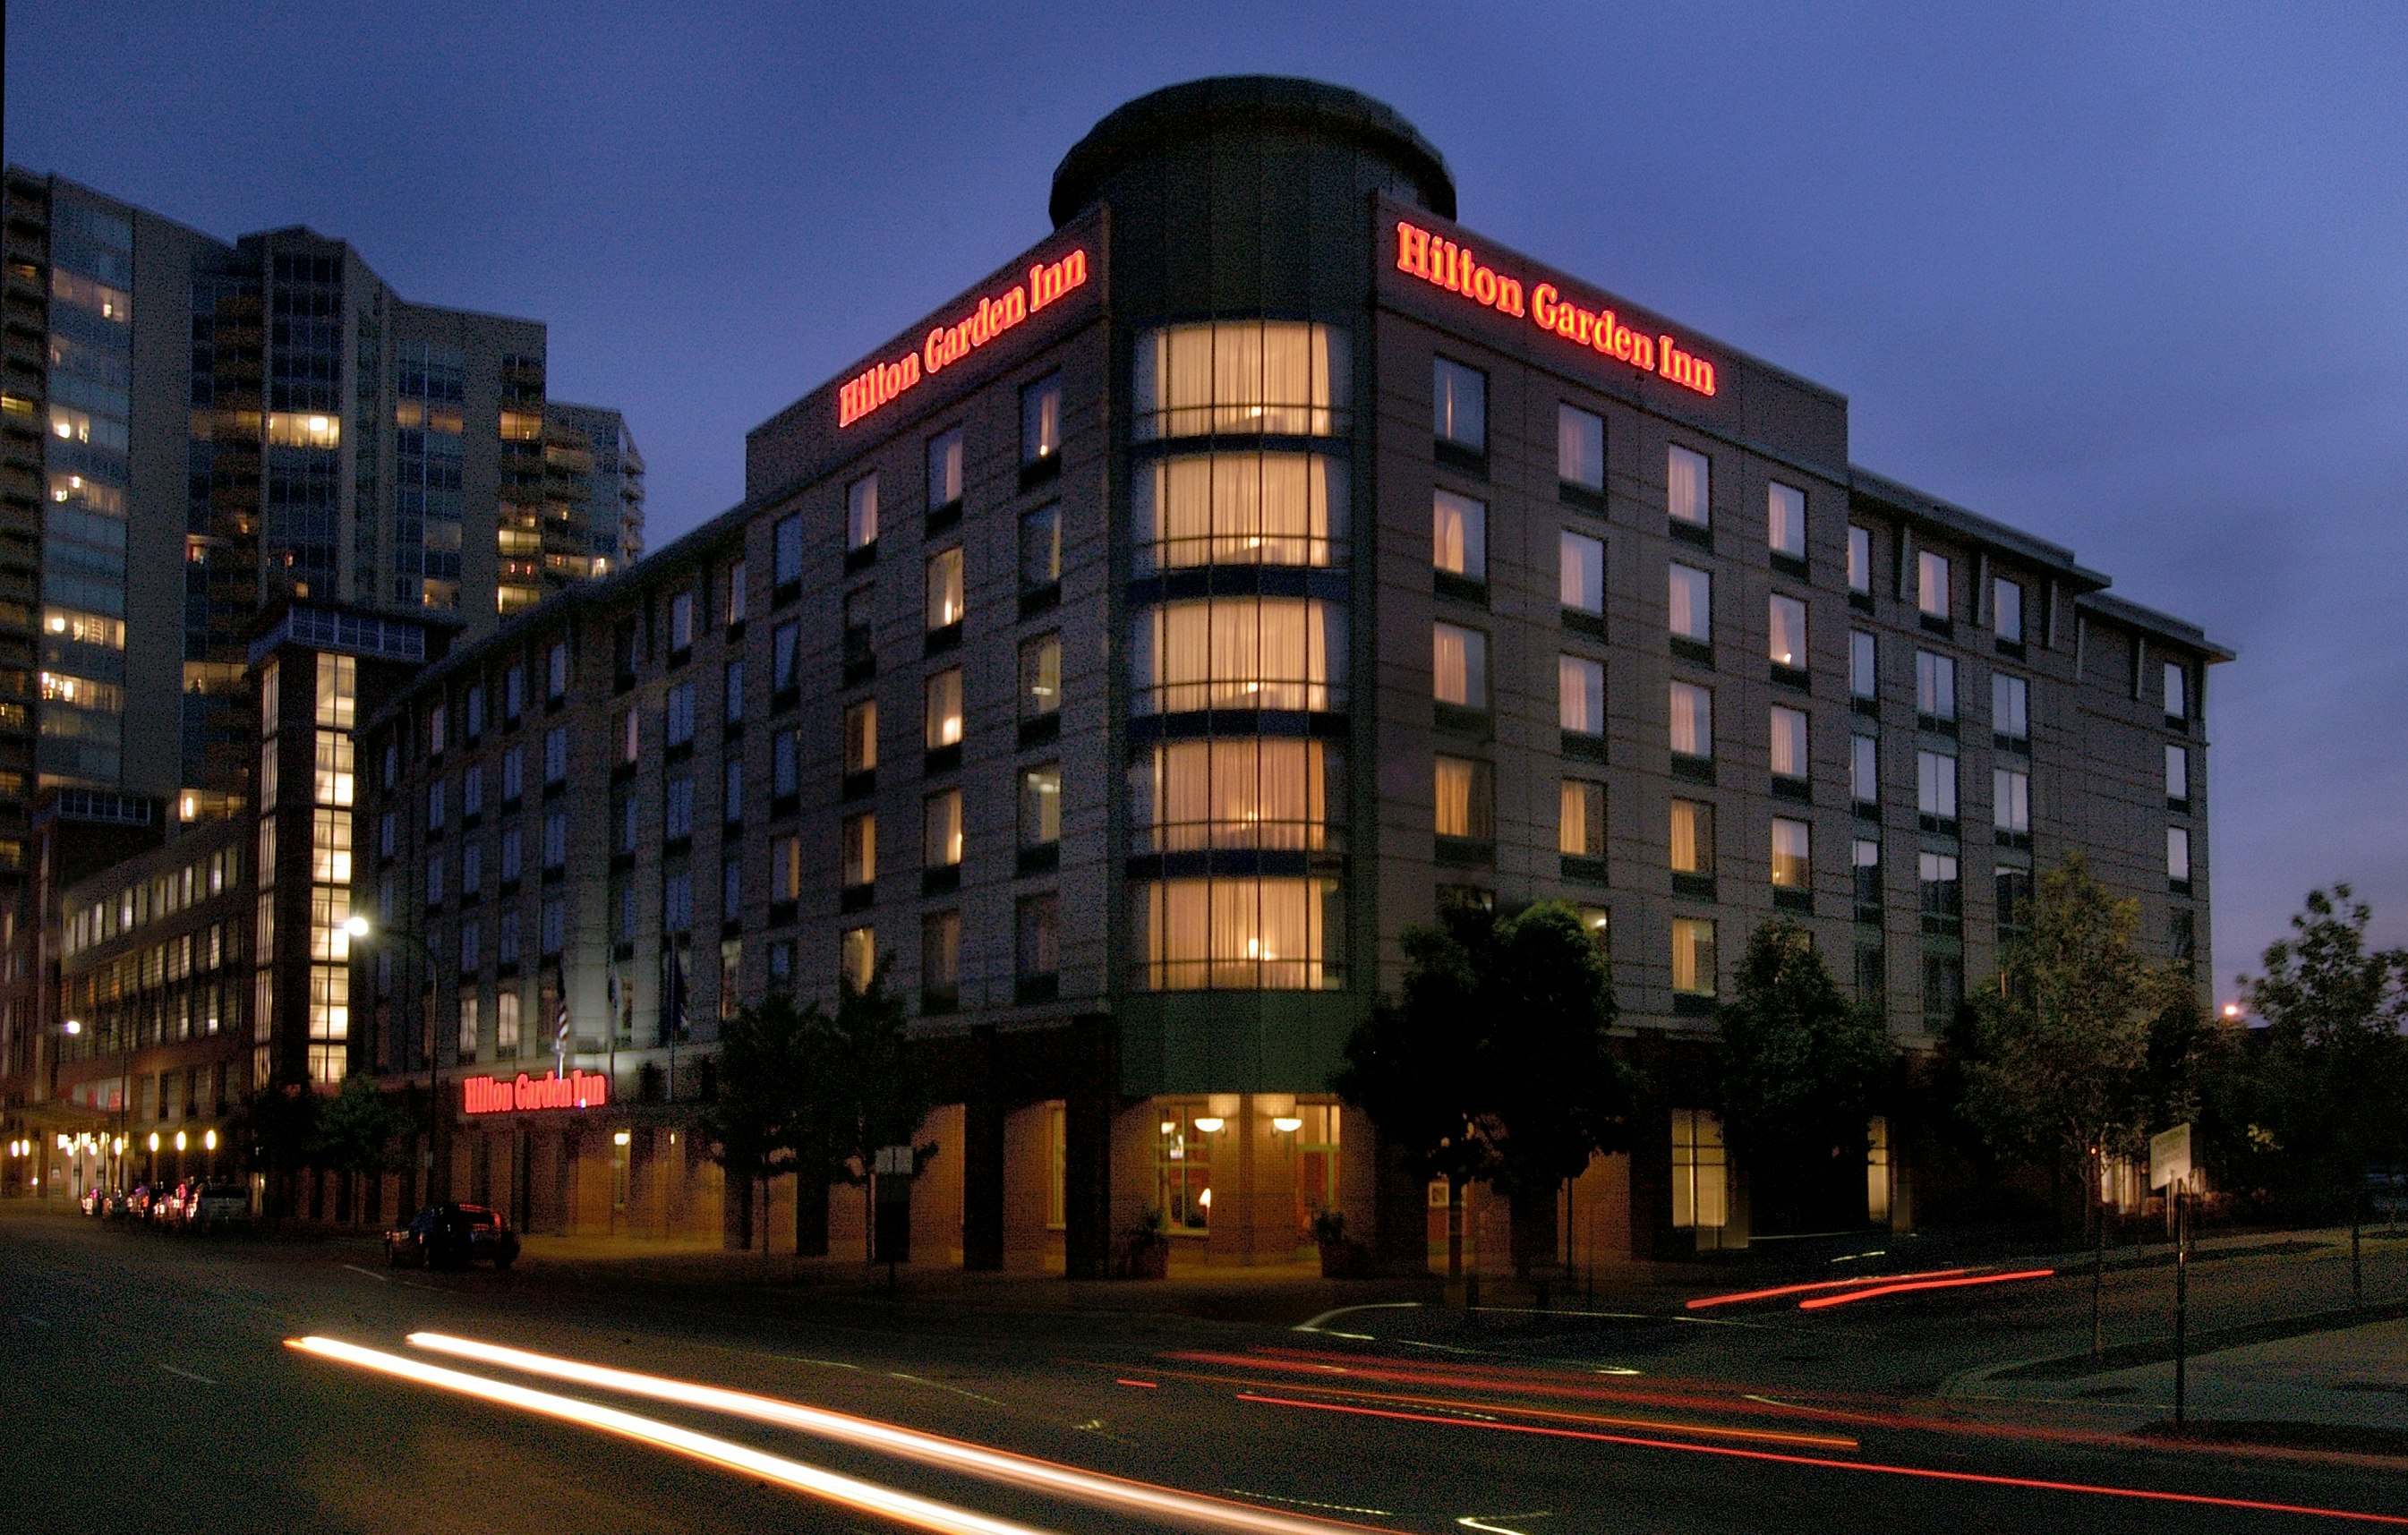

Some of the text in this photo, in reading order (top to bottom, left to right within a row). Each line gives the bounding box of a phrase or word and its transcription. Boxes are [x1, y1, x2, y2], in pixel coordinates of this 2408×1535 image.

[840, 250, 1086, 428] Hilton Garden Inn
[1397, 222, 1716, 397] Hilton Garden Inn
[465, 1070, 605, 1113] Hilton Garden Inn
